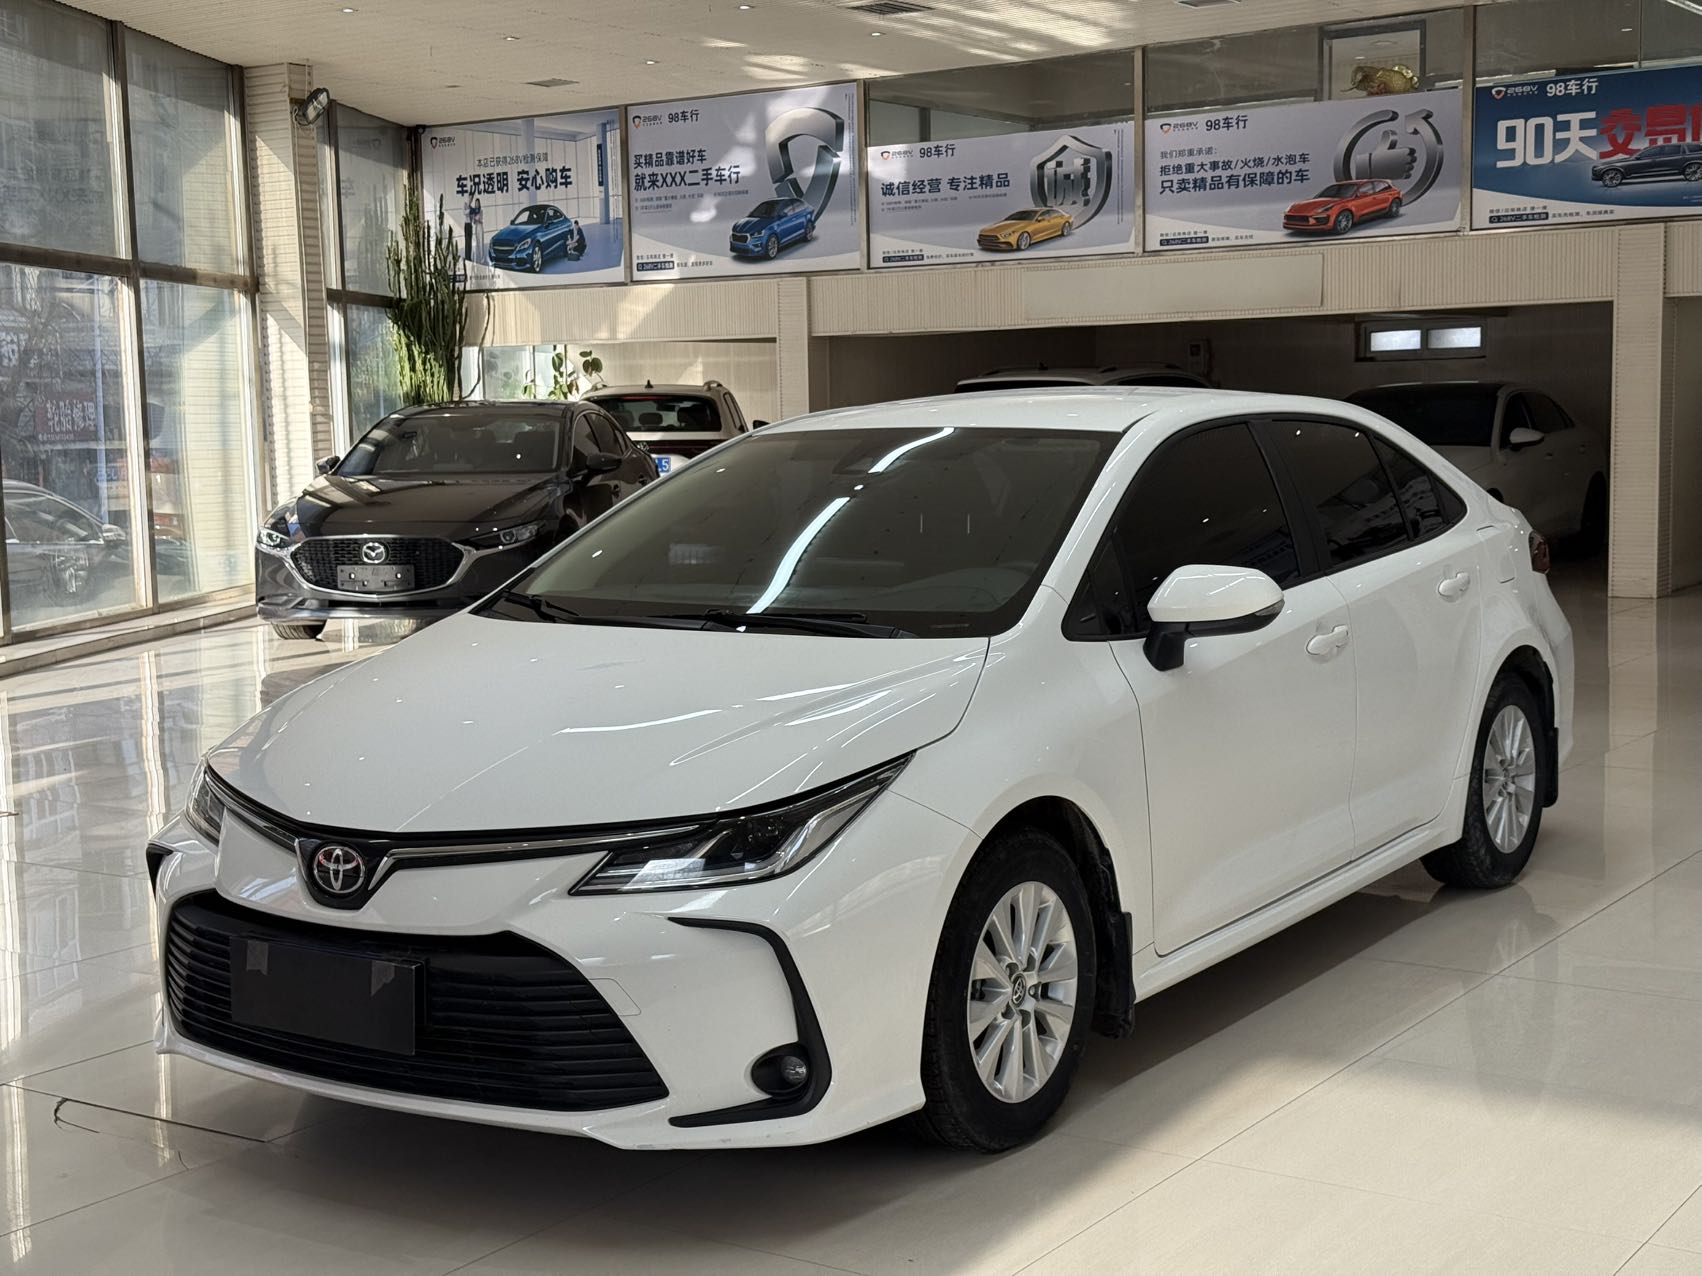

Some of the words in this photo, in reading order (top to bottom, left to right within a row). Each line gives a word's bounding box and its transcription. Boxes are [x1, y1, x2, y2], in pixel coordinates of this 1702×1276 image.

[1546, 78, 1599, 97] 98车行
[668, 109, 700, 124] 98车行
[1205, 114, 1248, 132] 98车行
[633, 148, 707, 170] 买精品靠谱好车
[919, 143, 956, 159] 98车行
[1160, 152, 1311, 177] 拒绝重大事故/火烧/水泡车
[456, 171, 509, 197] 车况透明
[517, 165, 573, 193] 安心购车
[633, 165, 741, 192] 就来XXX二手车行
[881, 178, 942, 197] 诚信经营
[947, 172, 1010, 192] 专注精品
[1159, 168, 1311, 195] 只卖精品有保障的车
